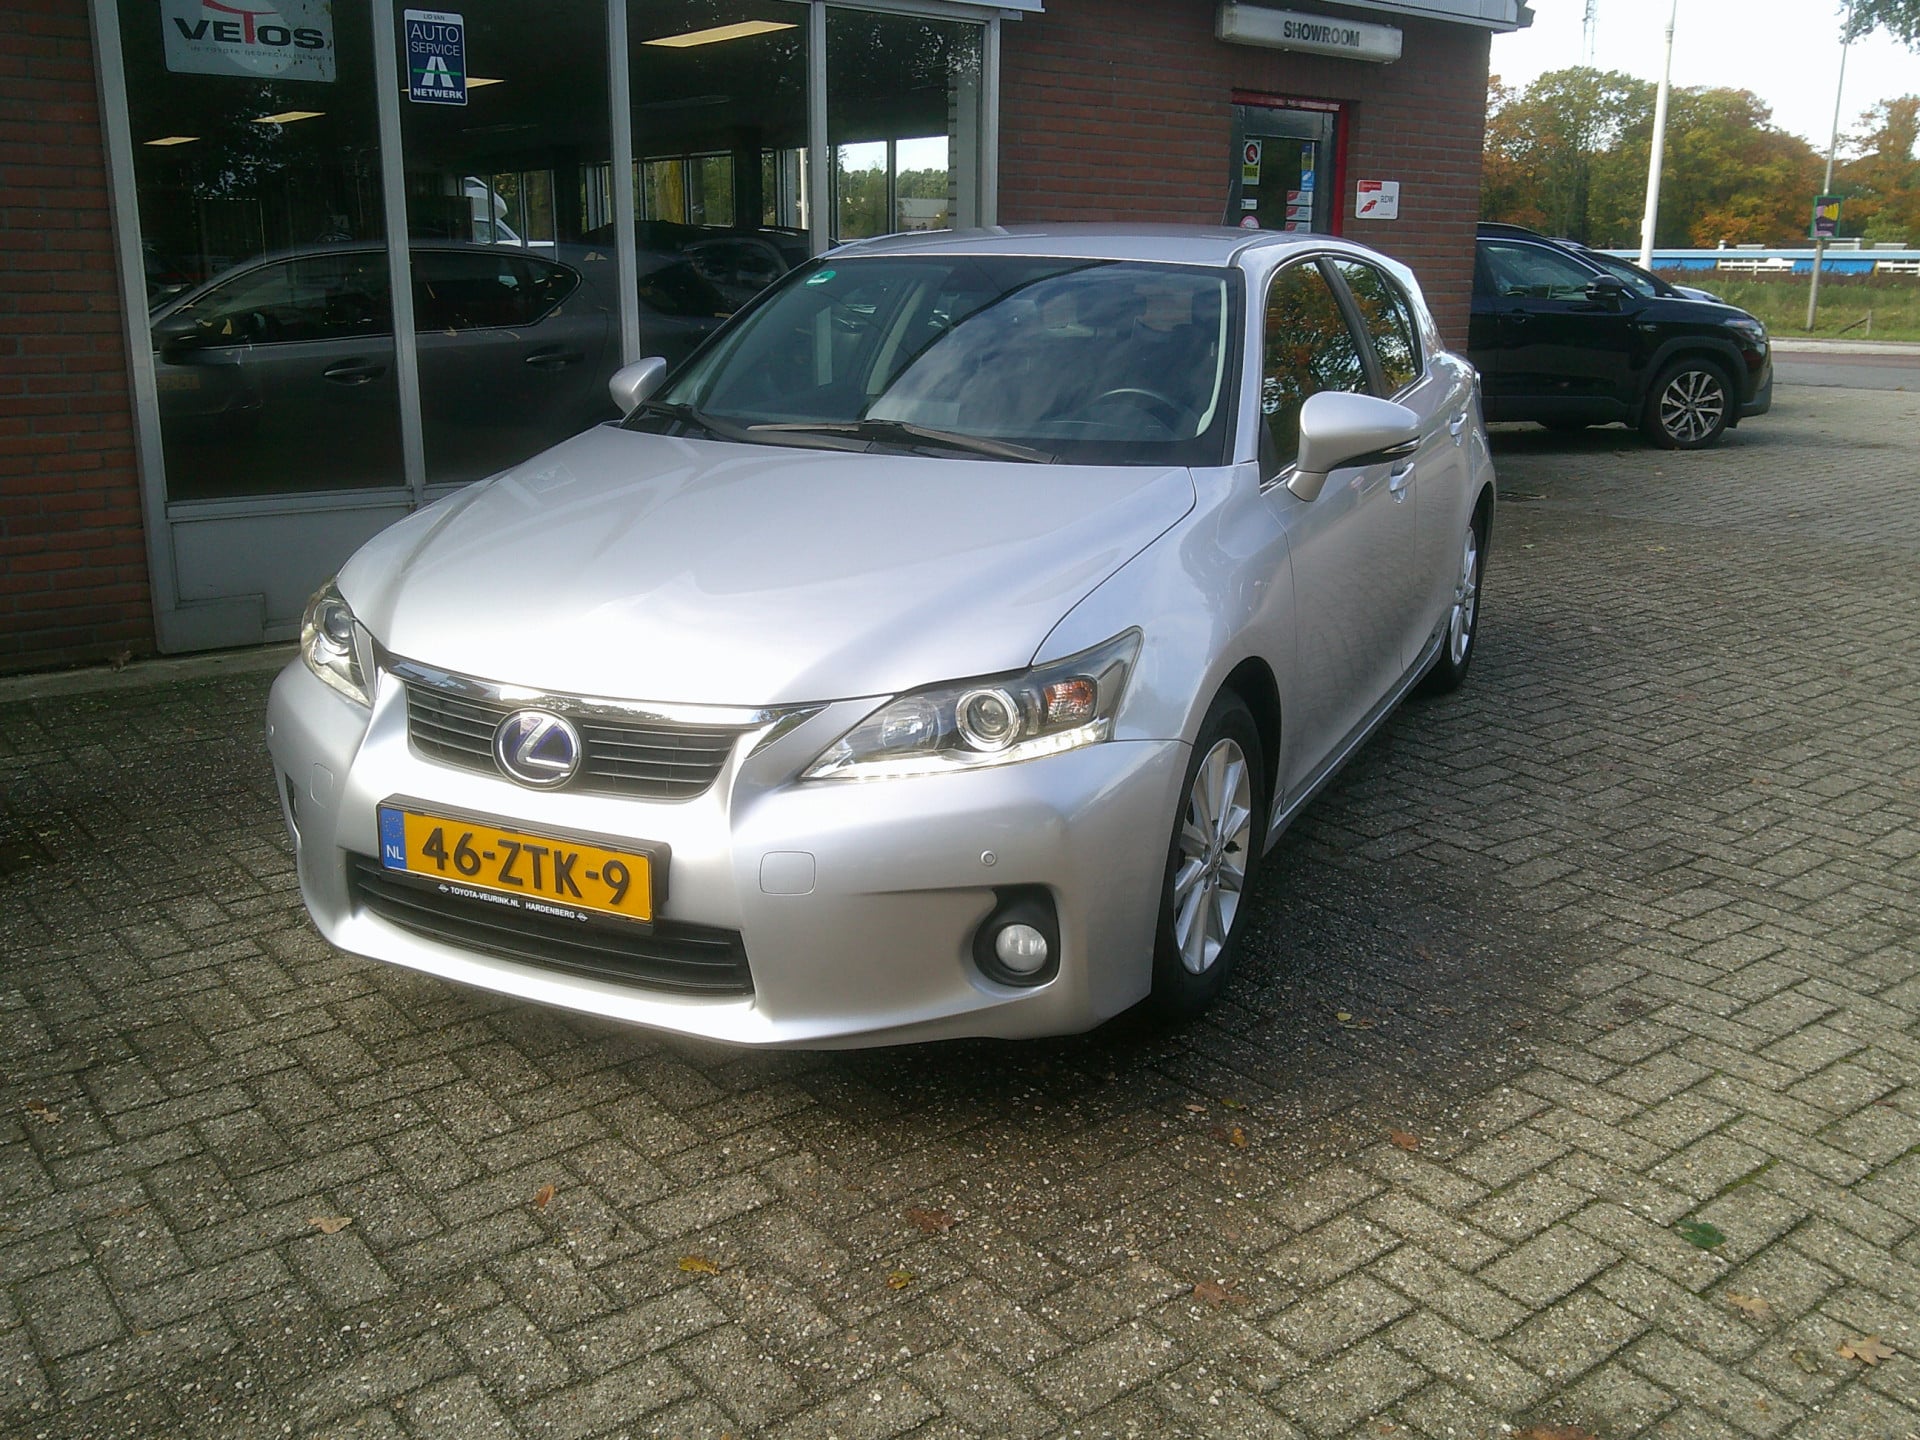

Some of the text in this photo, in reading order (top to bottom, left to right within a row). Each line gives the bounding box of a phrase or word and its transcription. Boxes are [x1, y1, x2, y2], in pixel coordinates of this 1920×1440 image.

[173, 13, 325, 49] VETOS
[411, 23, 459, 43] AUTO
[1283, 20, 1360, 47] SHOWROOM
[411, 41, 461, 57] SERVICE
[413, 87, 464, 100] NETWERK
[386, 845, 404, 861] NL
[422, 827, 630, 905] 46-ZTK-9
[450, 886, 575, 919] TOYOTA-VEURINK.NL HARDENBERG
